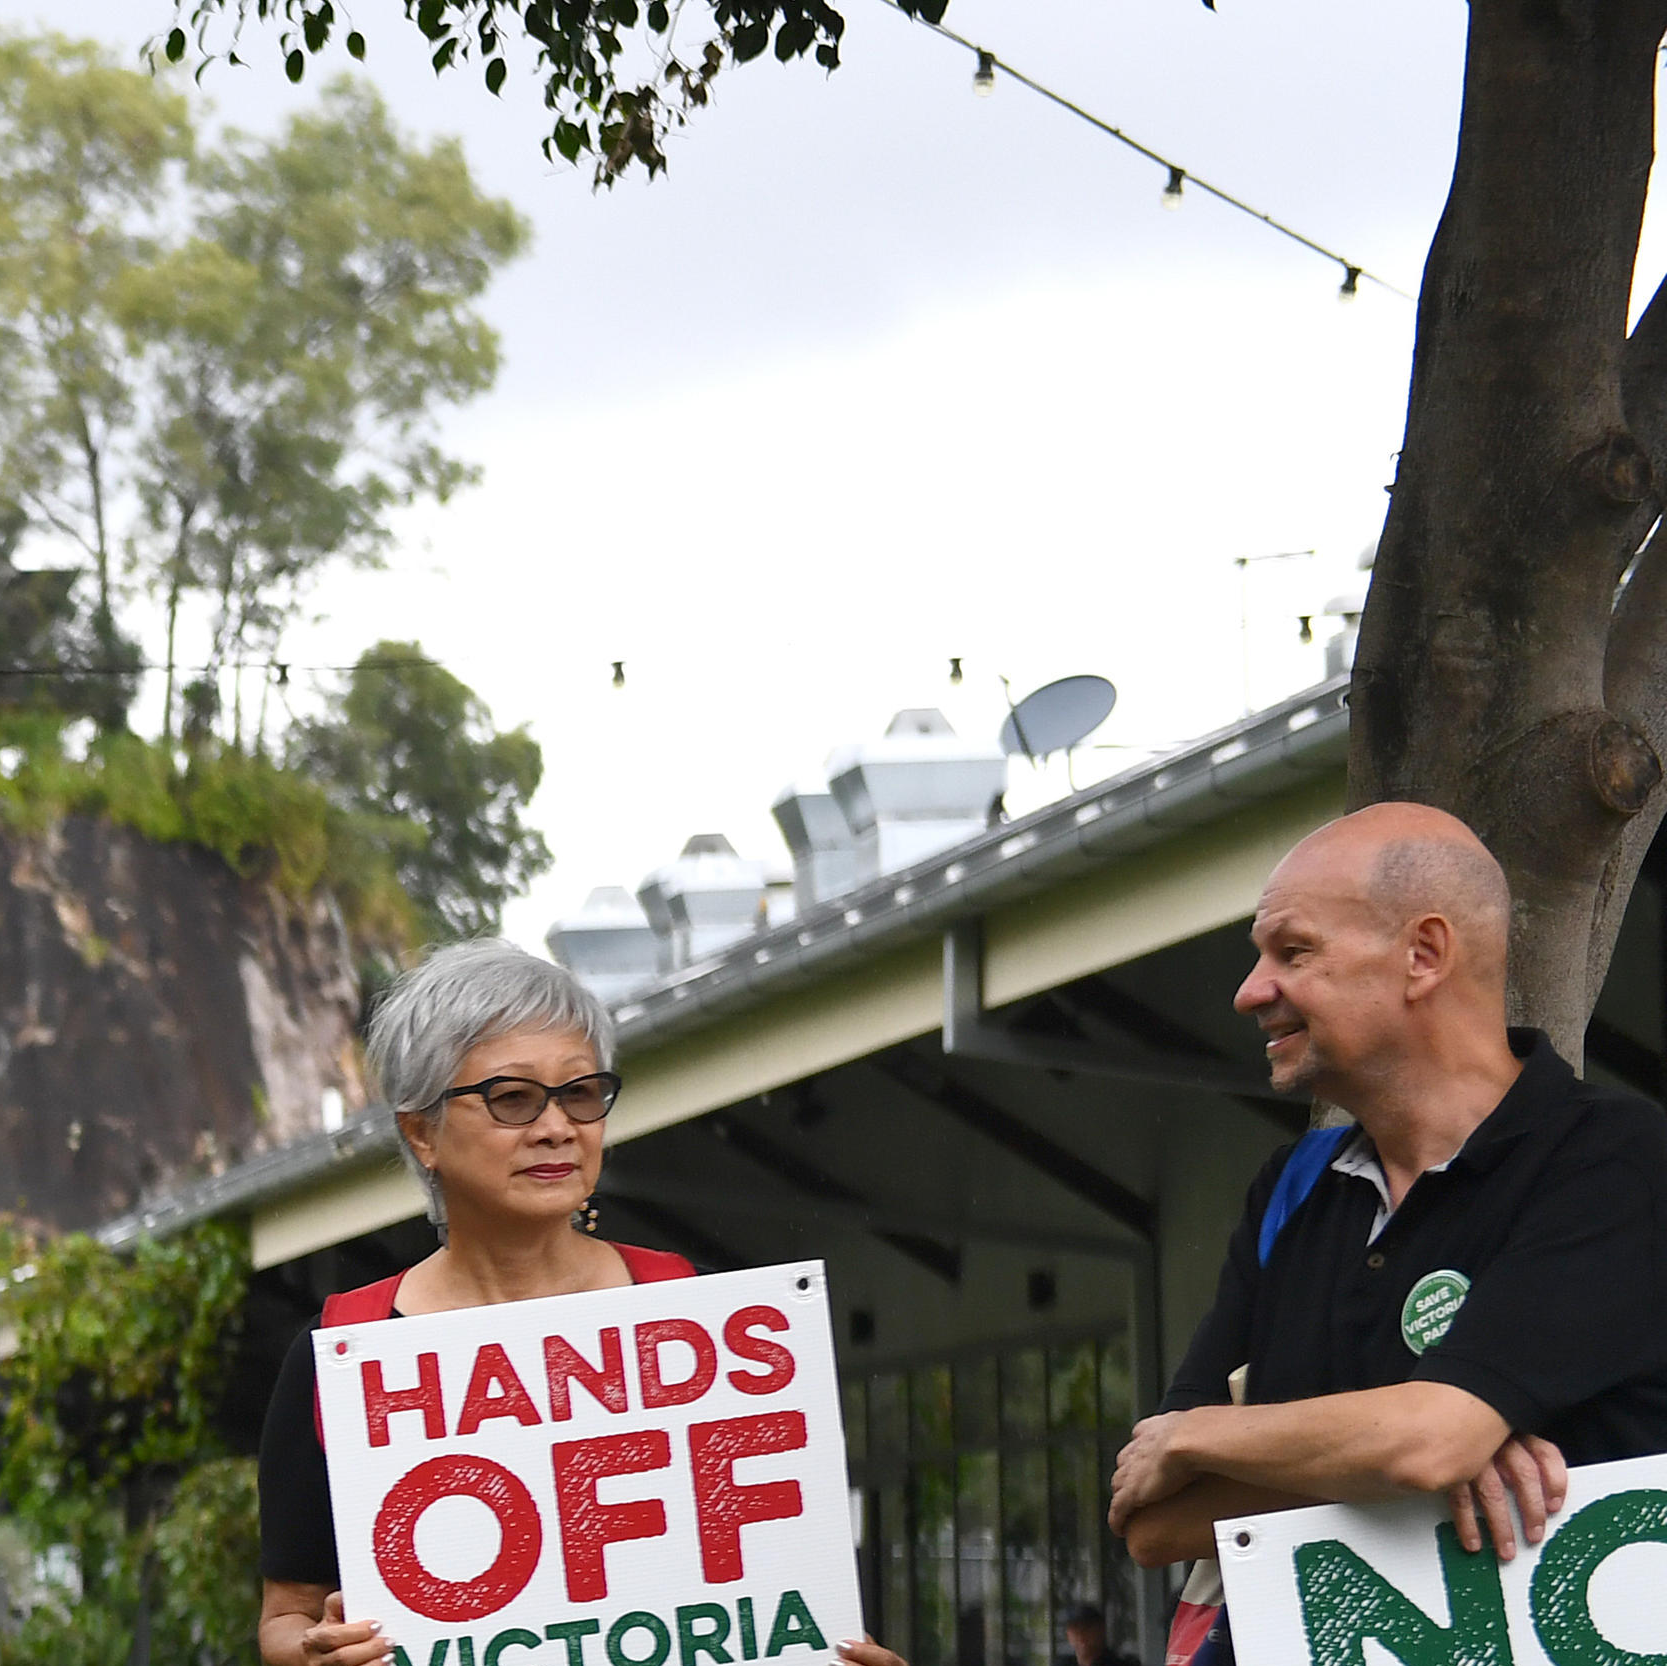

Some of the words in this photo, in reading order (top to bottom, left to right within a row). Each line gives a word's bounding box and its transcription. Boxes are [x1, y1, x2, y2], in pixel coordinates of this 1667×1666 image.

[1415, 1286, 1451, 1312] SAVE
[361, 1305, 796, 1448] HANDS
[372, 1410, 807, 1623] OFF
